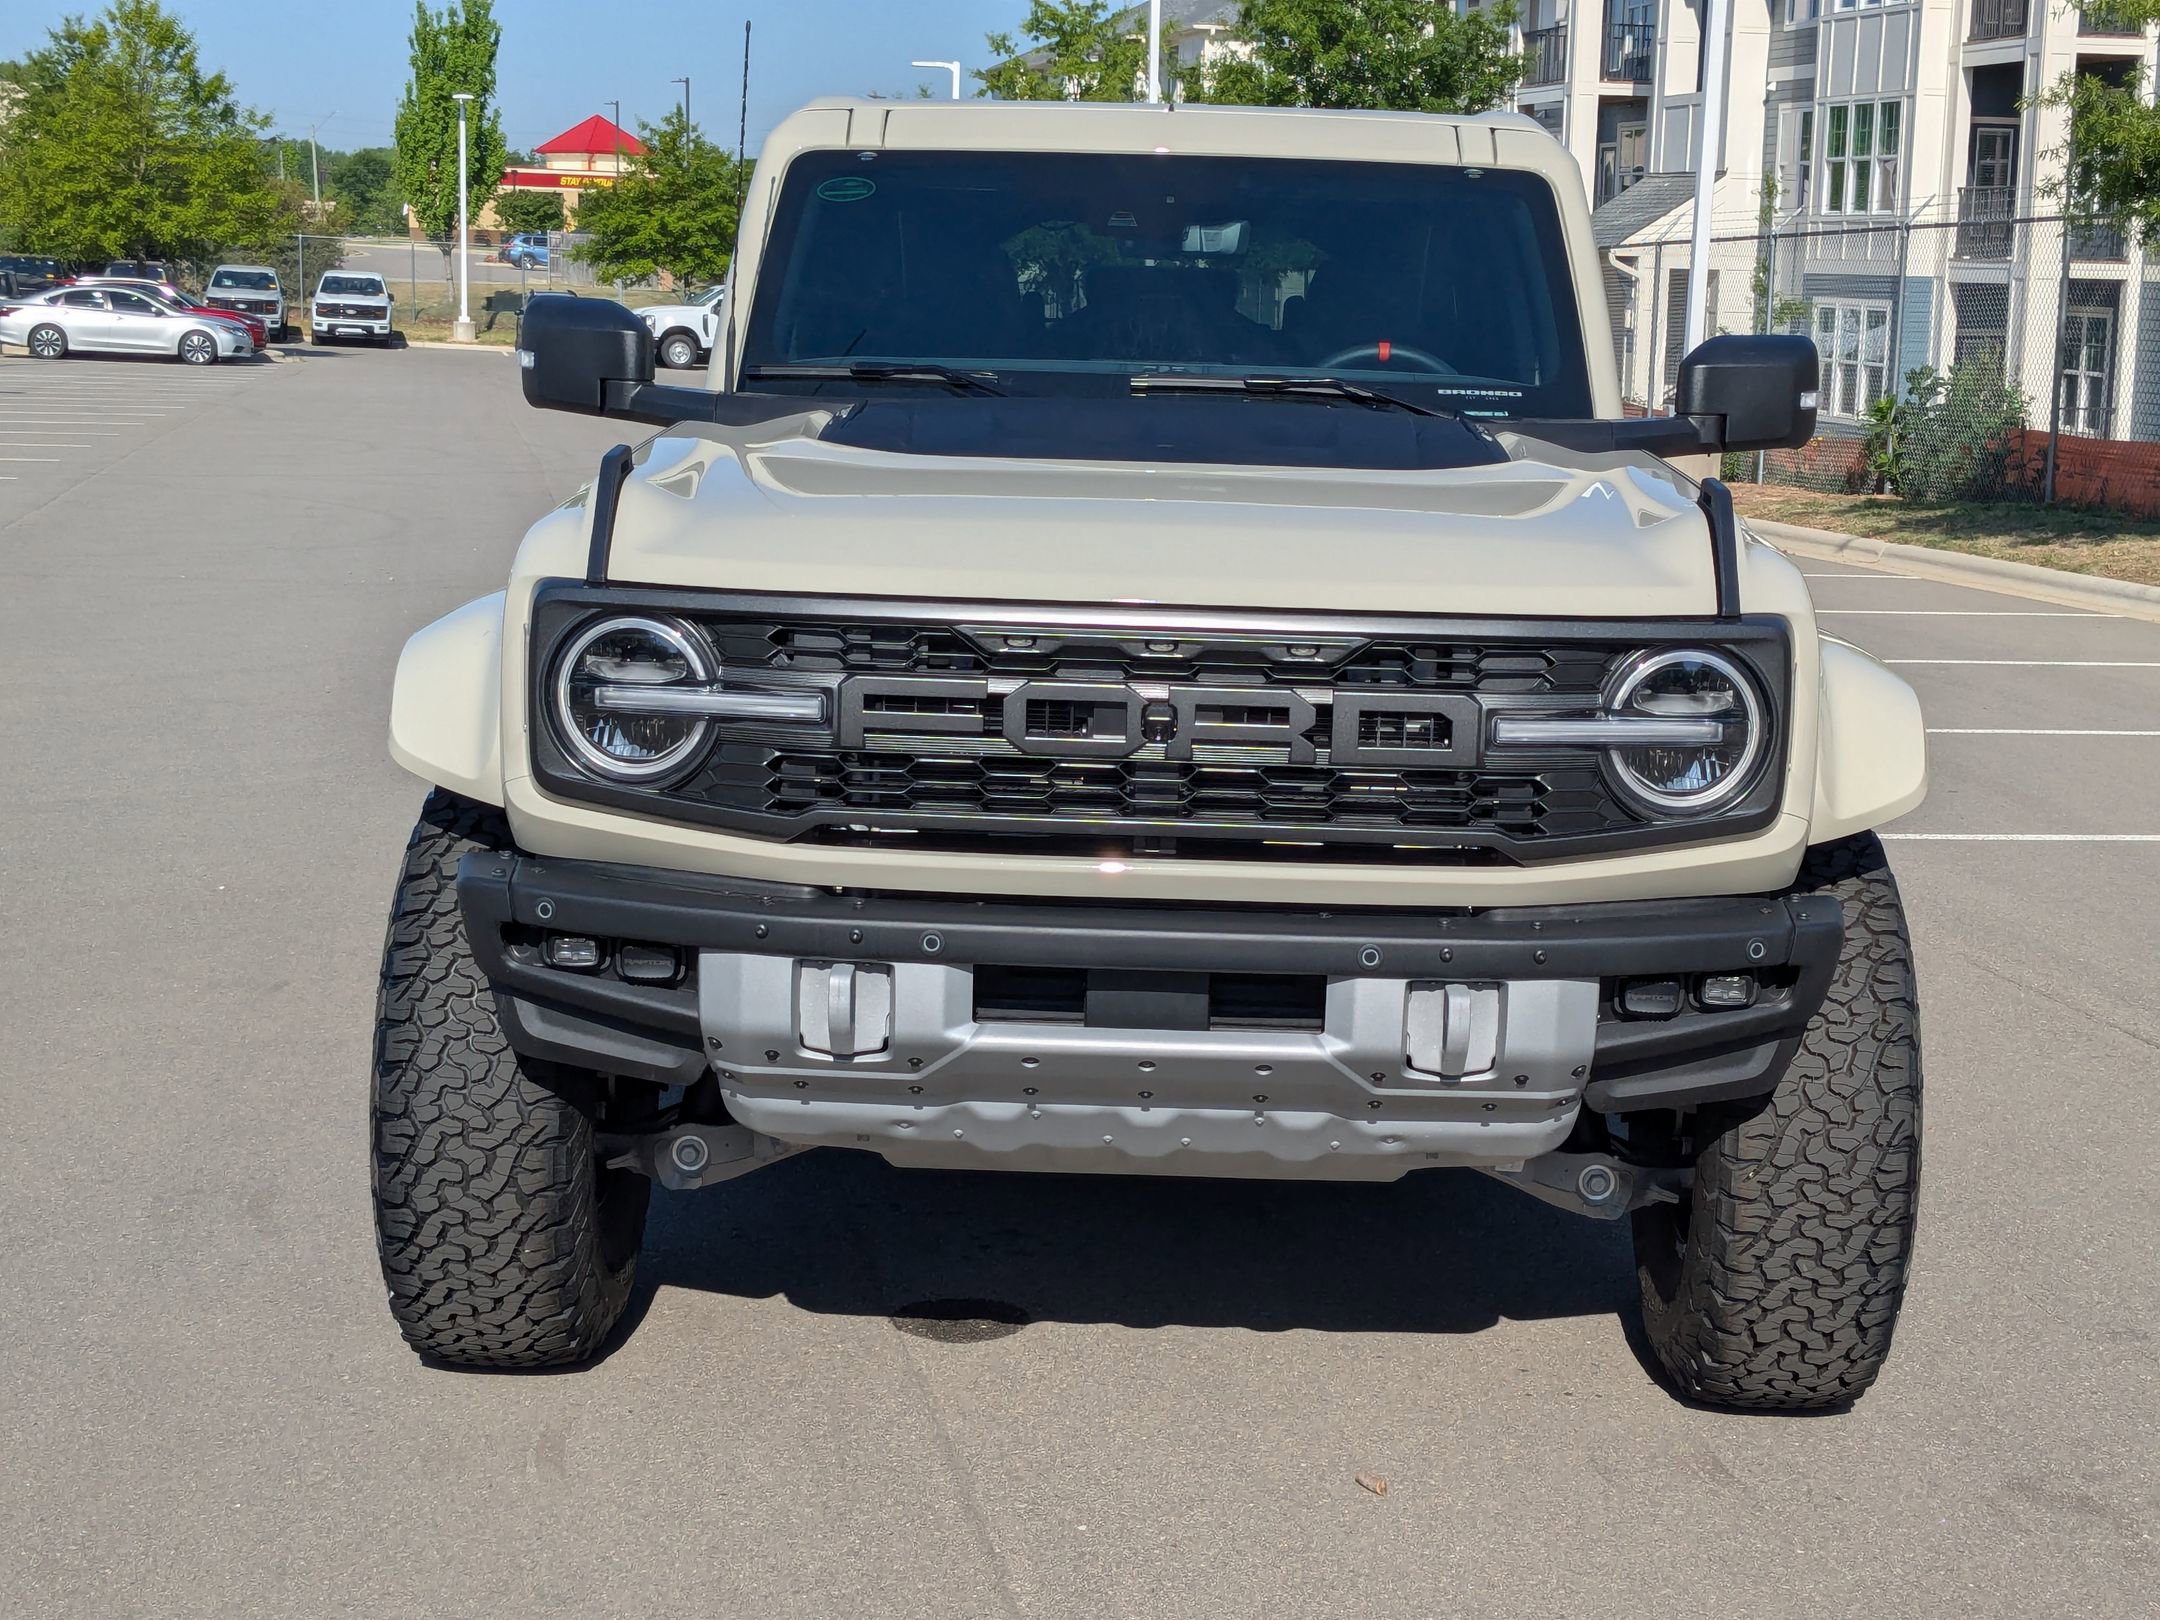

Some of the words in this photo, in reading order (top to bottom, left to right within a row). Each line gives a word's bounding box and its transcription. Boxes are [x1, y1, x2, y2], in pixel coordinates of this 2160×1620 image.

[560, 176, 580, 186] STAY
[1437, 389, 1523, 397] BRONCO
[839, 675, 1482, 768] FORD
[623, 958, 672, 967] RAPTOR
